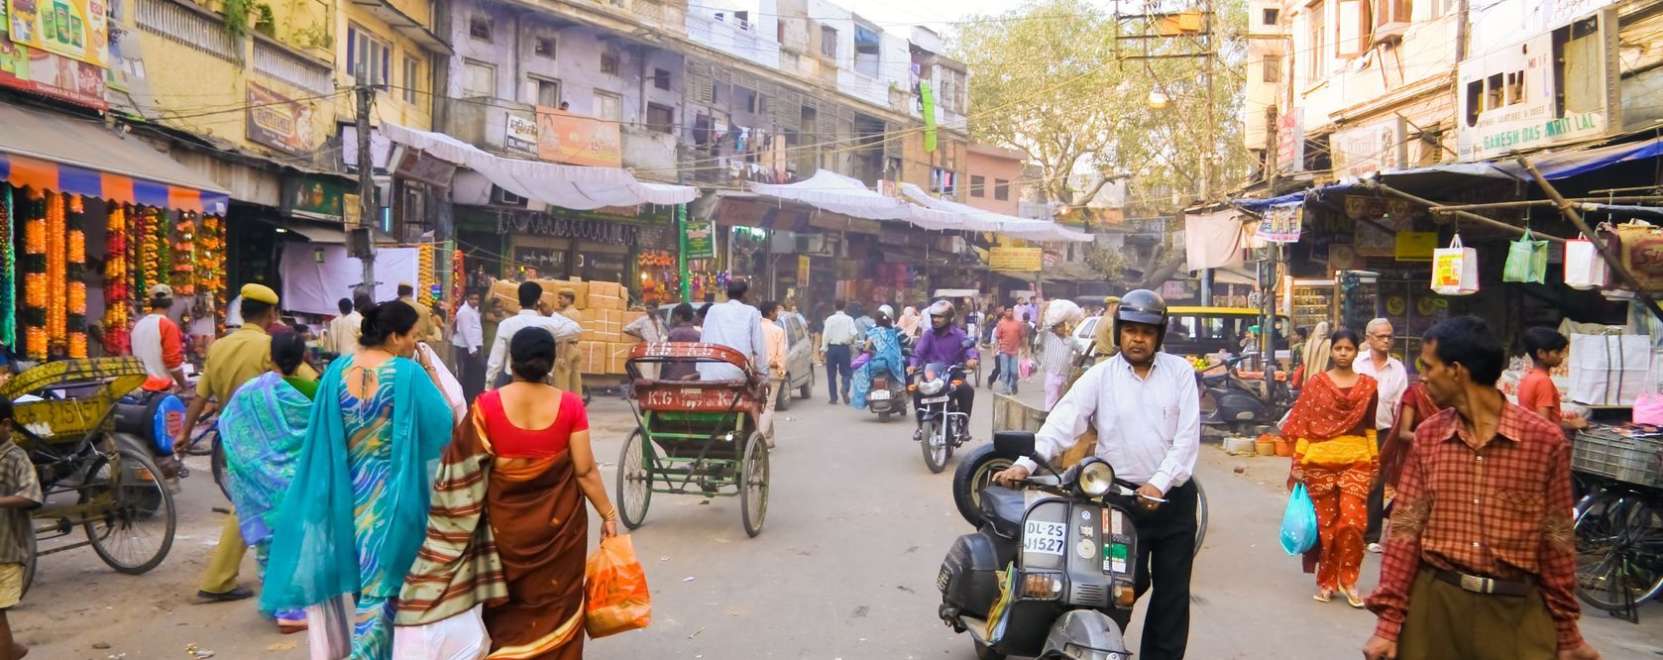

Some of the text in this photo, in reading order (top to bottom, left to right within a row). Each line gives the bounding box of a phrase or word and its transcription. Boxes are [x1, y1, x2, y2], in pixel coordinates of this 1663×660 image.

[1483, 132, 1520, 149] GANESH
[1522, 125, 1541, 143] DAS
[1575, 114, 1595, 130] LAL
[1024, 539, 1064, 553] J1527
